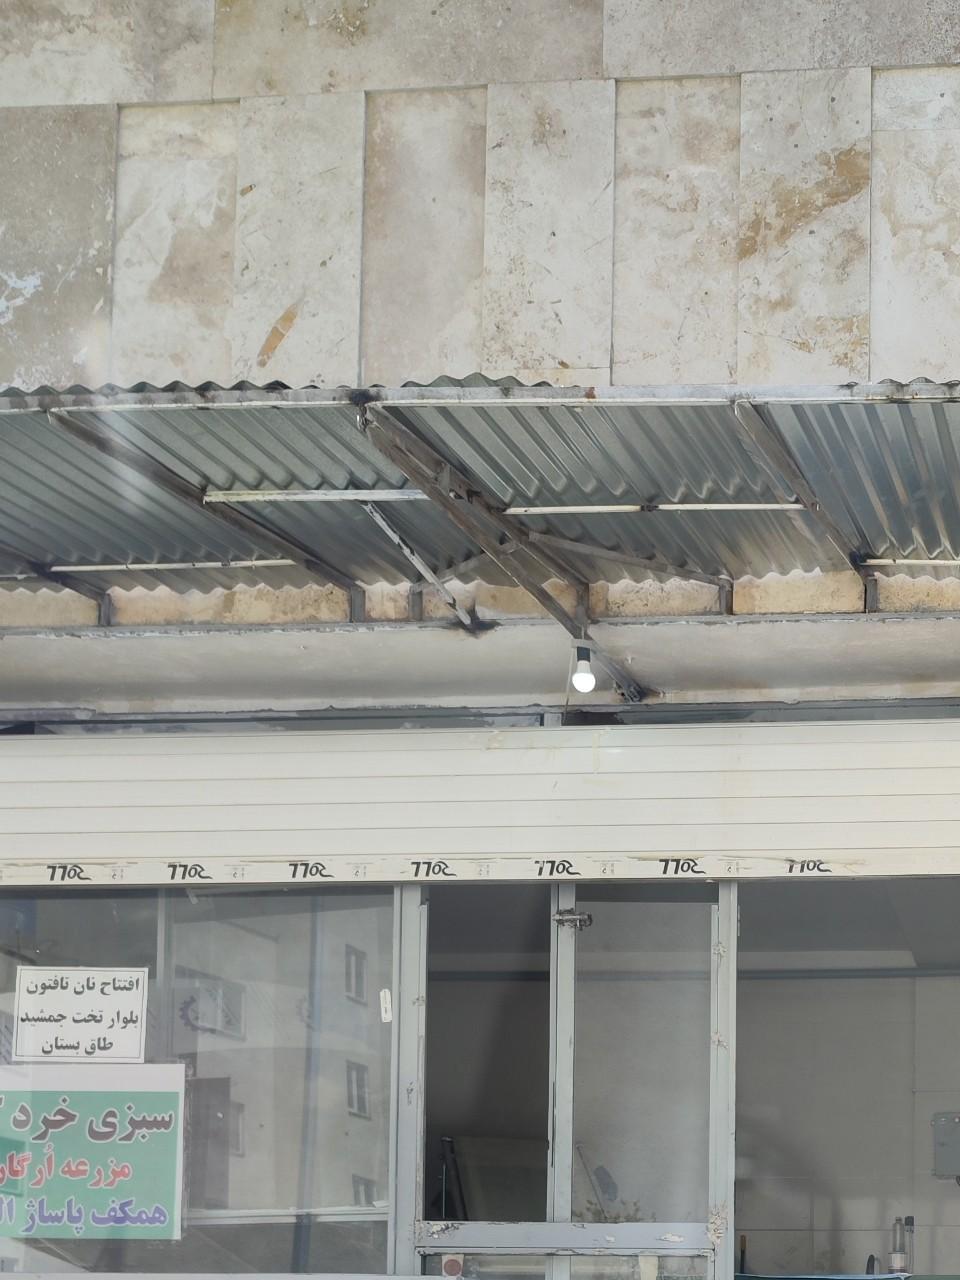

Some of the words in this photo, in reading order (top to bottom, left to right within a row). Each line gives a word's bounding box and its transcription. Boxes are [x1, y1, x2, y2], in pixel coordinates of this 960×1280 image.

[26, 975, 70, 996] تافتون
[73, 976, 96, 996] نان
[100, 976, 139, 996] افتتاح
[20, 1008, 67, 1028] جمشید
[72, 1009, 103, 1024] تخت
[107, 1008, 139, 1029] بلوار
[41, 1036, 80, 1056] بستان
[84, 1036, 114, 1055] طاق
[11, 1096, 79, 1142] خرد
[87, 1104, 174, 1142] سبزی
[60, 1158, 132, 1188] مزرعه
[21, 1198, 84, 1235] پاساژ
[90, 1199, 169, 1226] همکف
